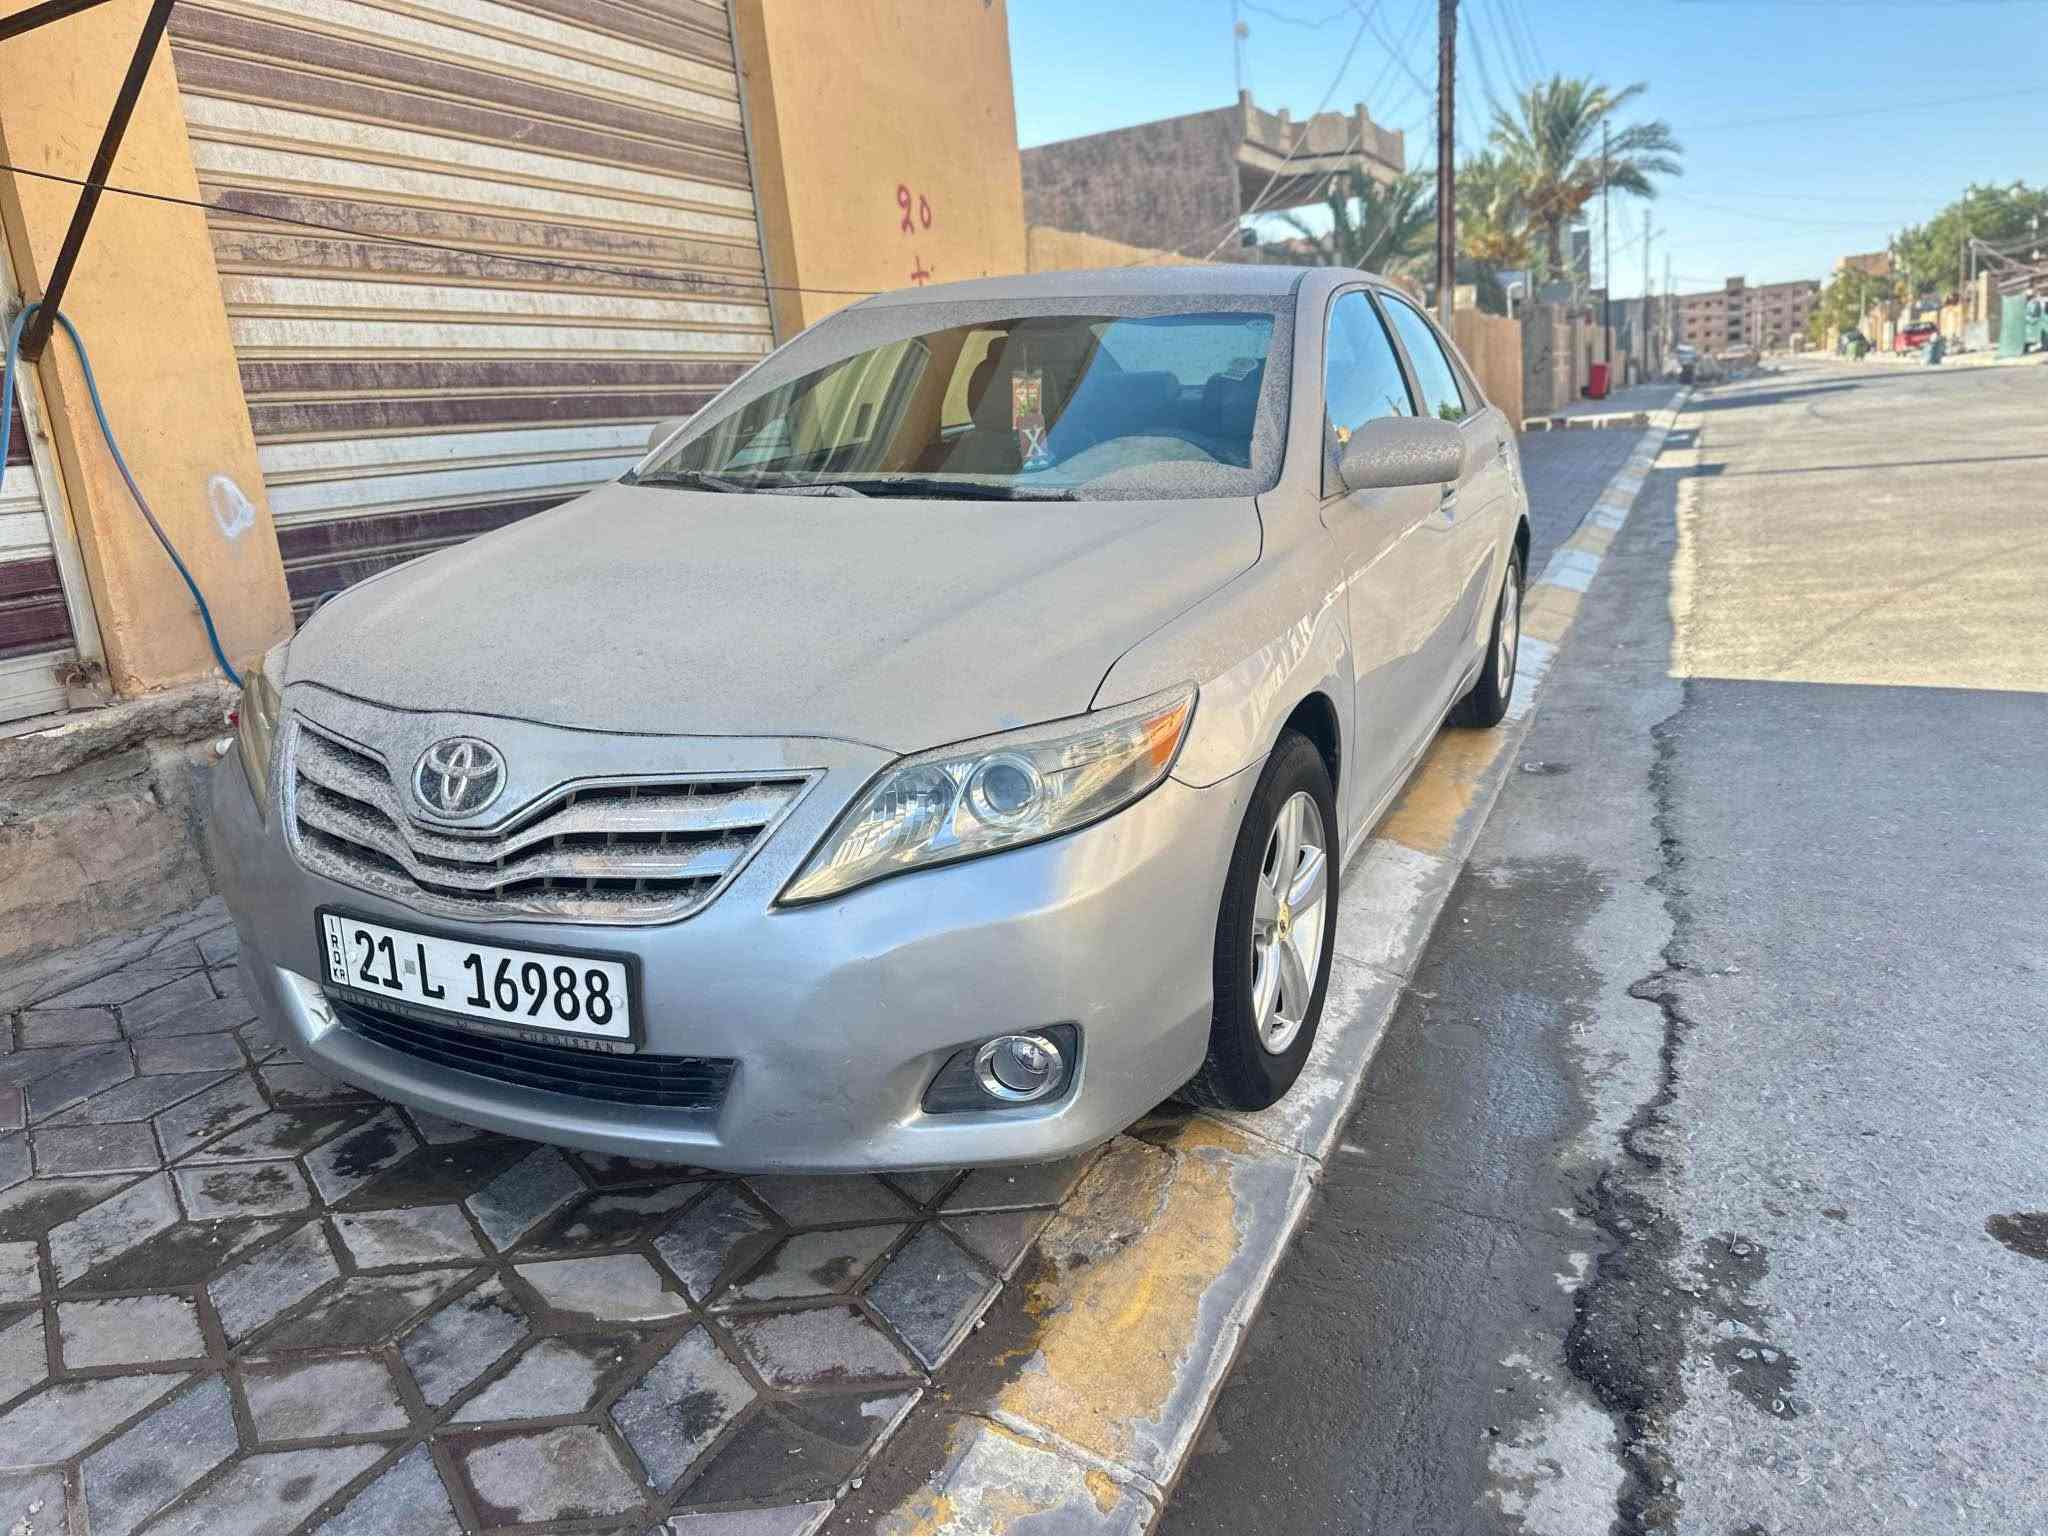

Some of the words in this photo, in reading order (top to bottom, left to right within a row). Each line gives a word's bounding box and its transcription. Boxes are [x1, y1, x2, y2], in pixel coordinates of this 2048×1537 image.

[355, 930, 402, 992] 21
[417, 943, 445, 1000] L
[463, 953, 613, 1025] 16988
